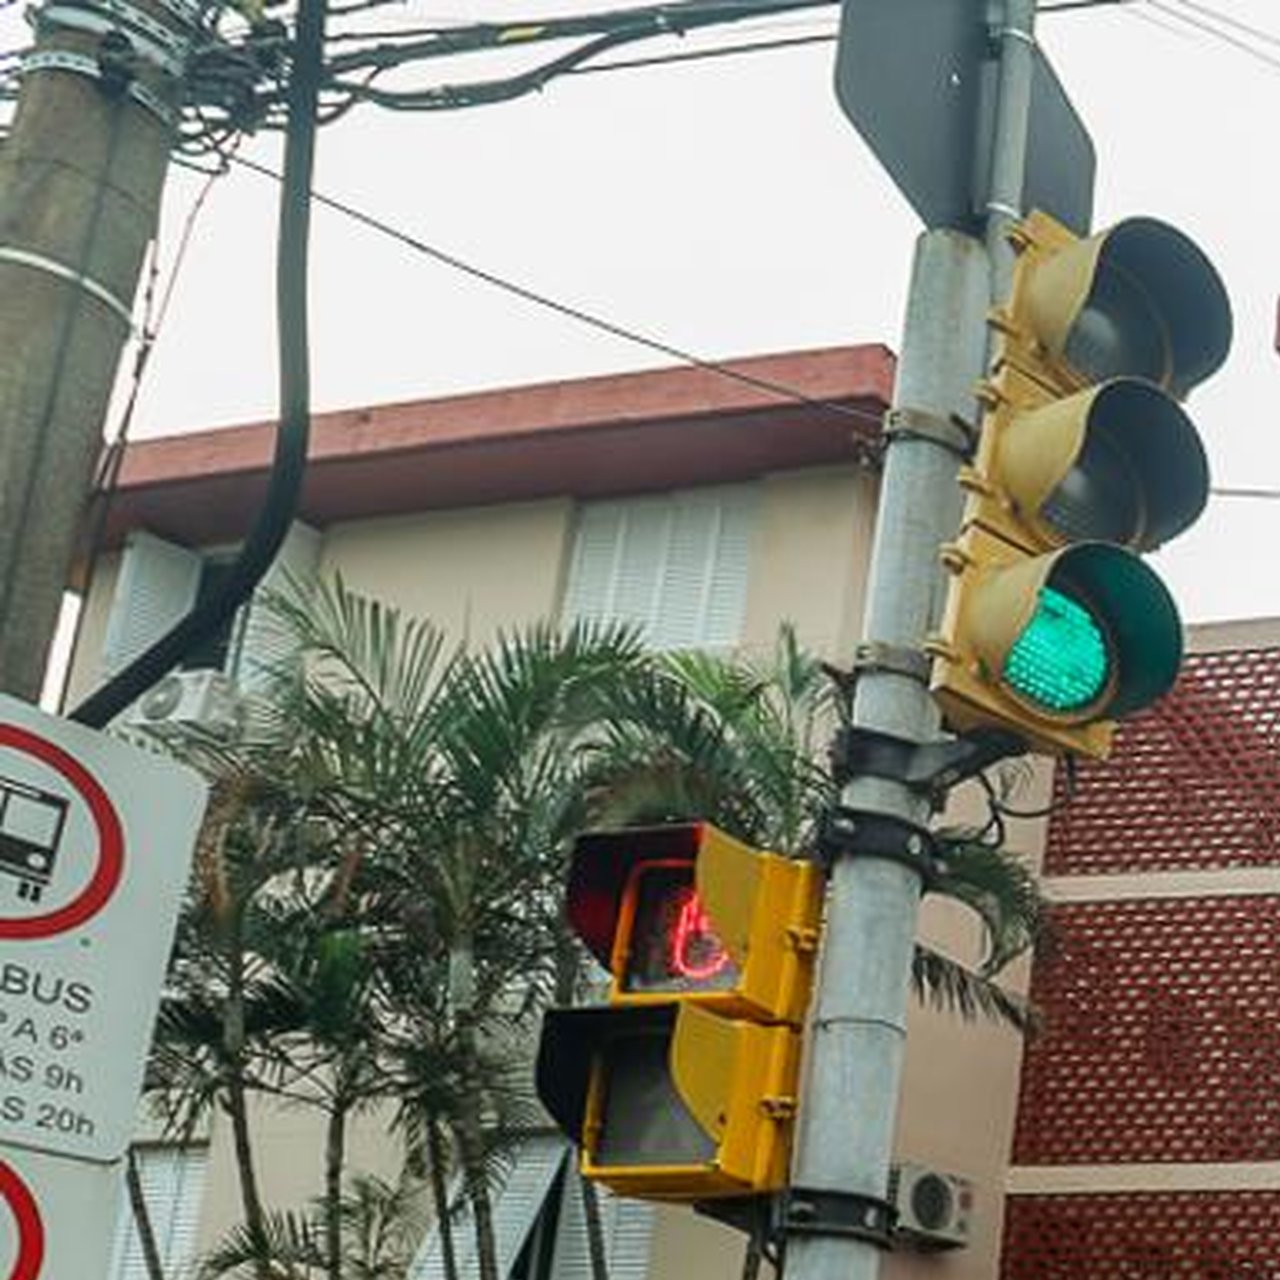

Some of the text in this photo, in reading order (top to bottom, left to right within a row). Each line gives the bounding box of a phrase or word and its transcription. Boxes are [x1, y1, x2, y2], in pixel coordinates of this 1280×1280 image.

[0, 963, 93, 1014] BUS
[12, 1018, 38, 1044] A
[44, 1063, 82, 1094] 9h
[0, 1096, 95, 1137] S 20h
